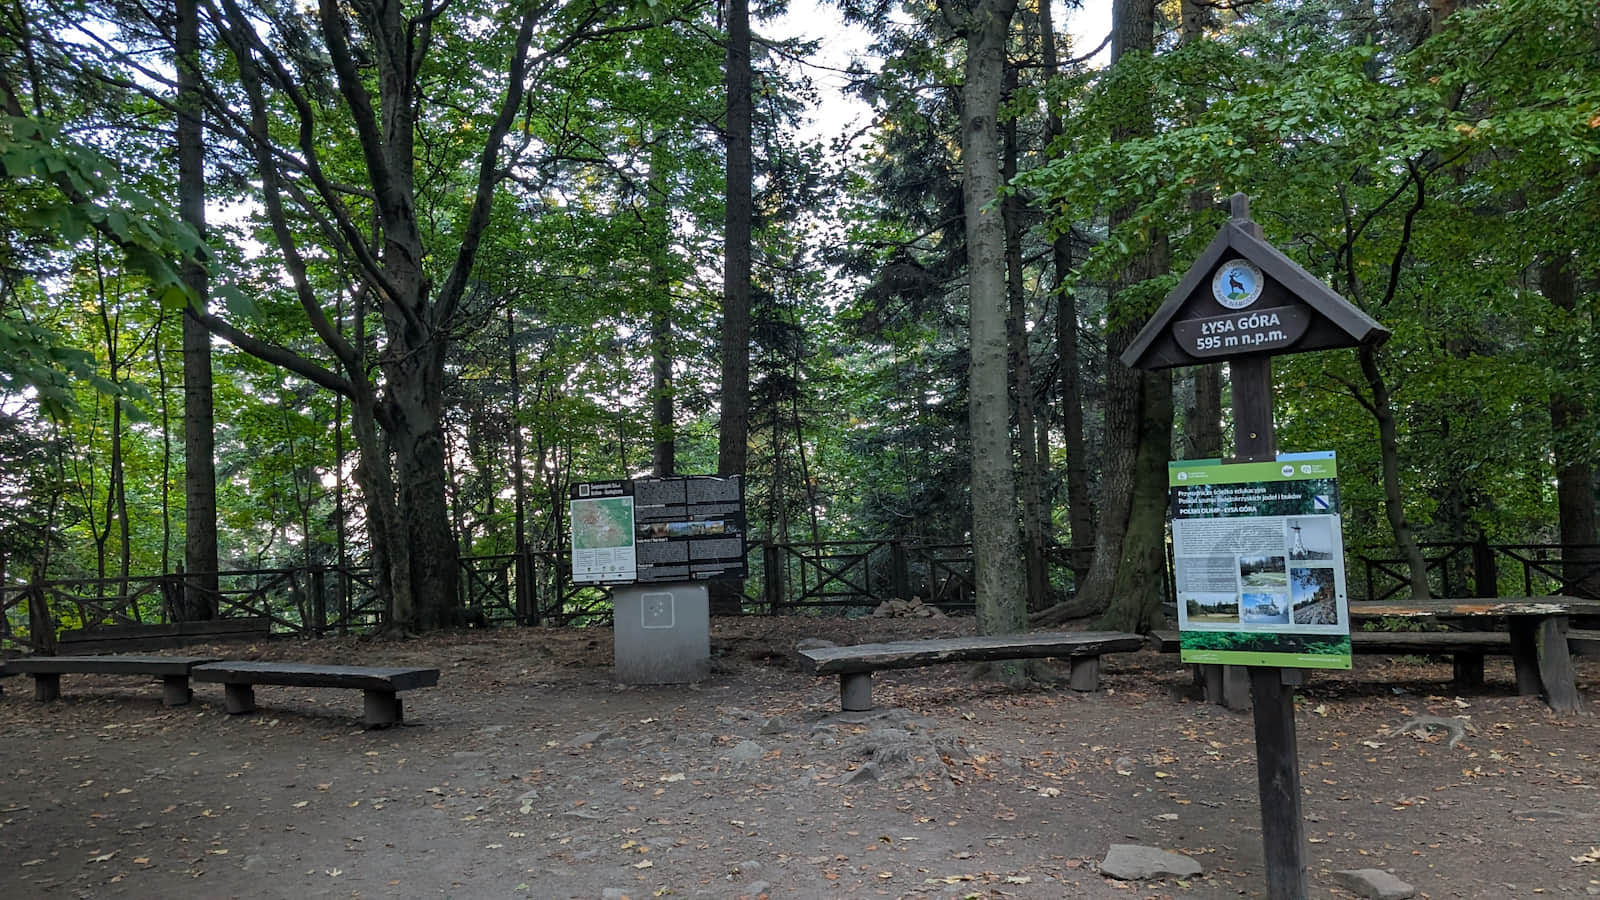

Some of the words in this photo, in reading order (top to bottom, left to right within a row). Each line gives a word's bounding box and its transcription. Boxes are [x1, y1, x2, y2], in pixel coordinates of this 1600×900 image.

[1201, 319, 1235, 335] ŁYSA
[1237, 313, 1280, 330] GÓRA
[1196, 336, 1221, 350] 595
[1224, 335, 1238, 346] m
[1241, 330, 1287, 346] n.p.m.
[1239, 504, 1257, 513] GÓRA
